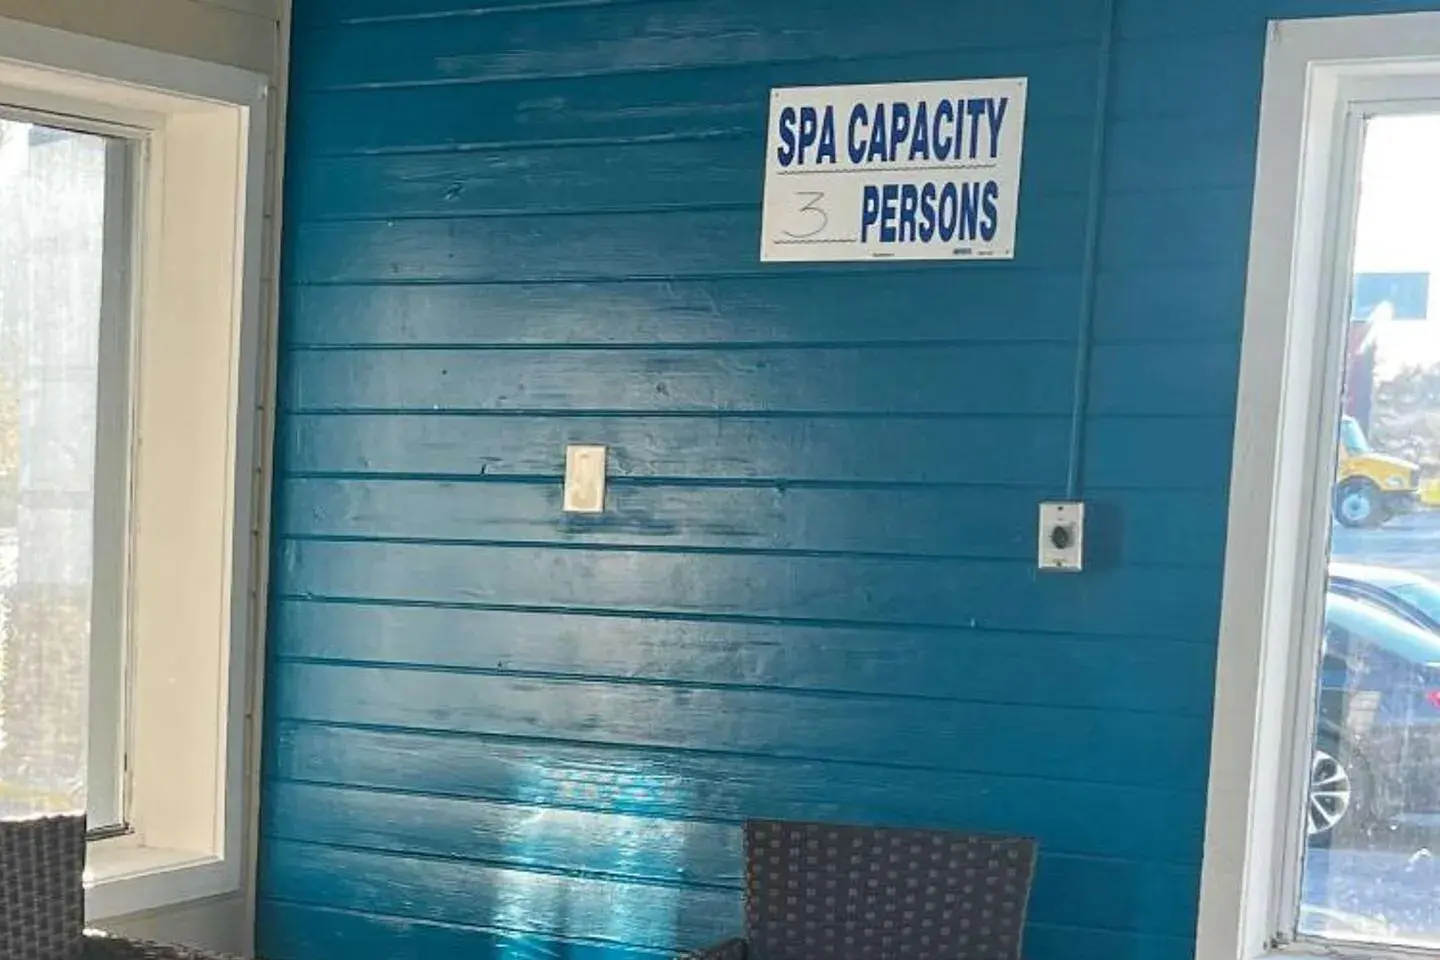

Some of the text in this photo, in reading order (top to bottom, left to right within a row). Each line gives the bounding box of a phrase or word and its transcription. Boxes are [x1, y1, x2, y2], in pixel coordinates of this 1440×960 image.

[777, 97, 1009, 167] SPA CAPACITY
[782, 180, 1000, 244] 3 PERSONS
